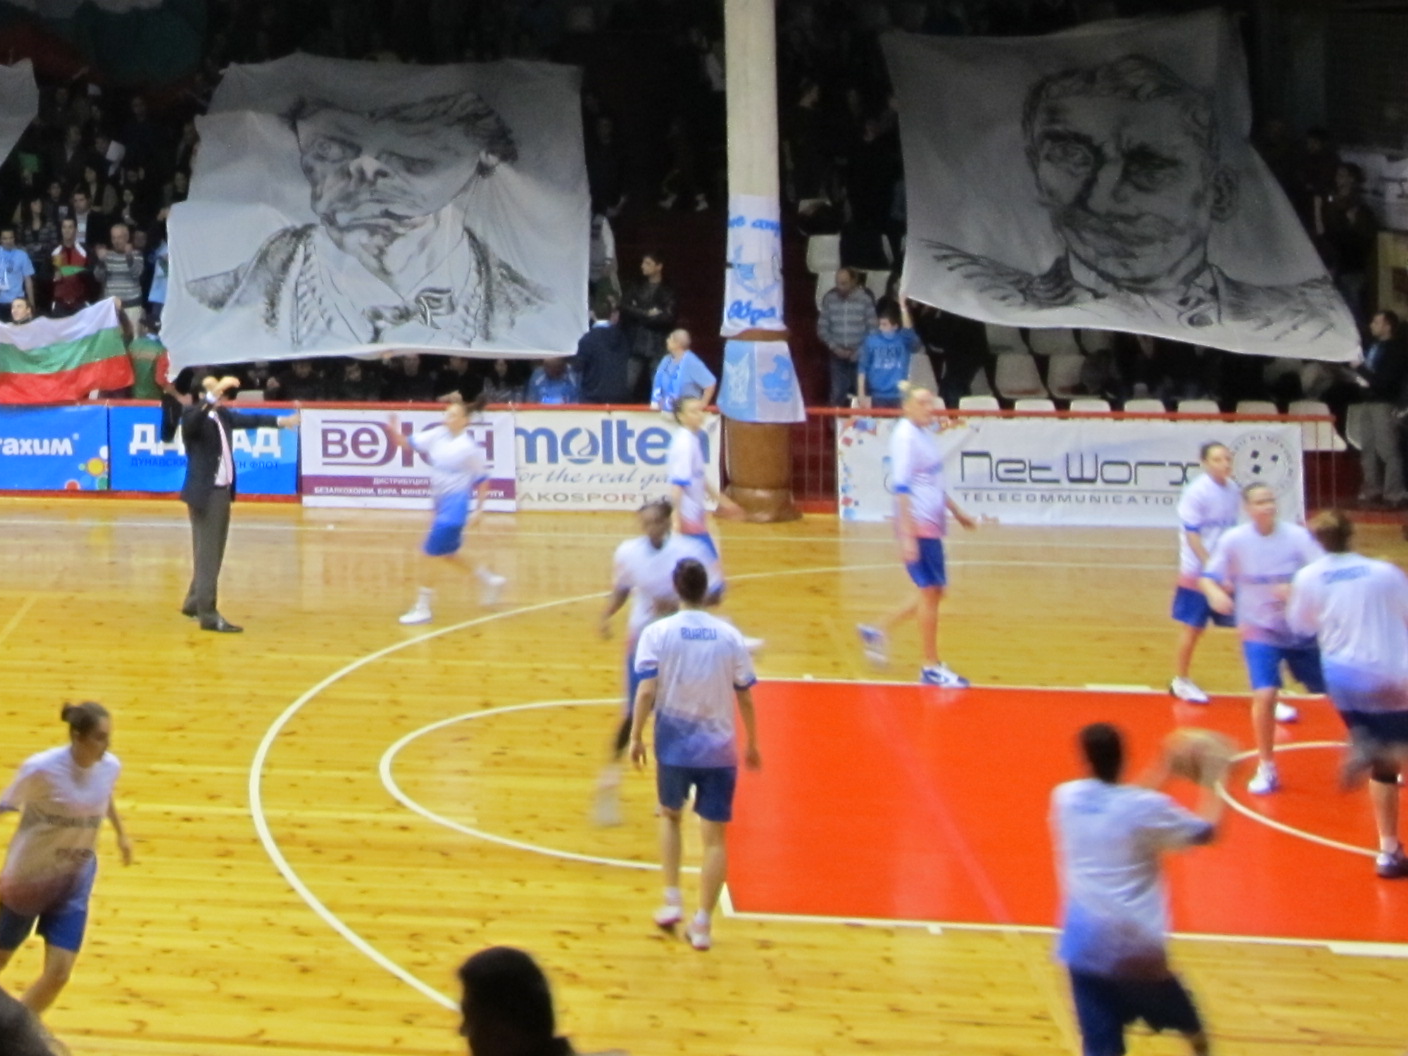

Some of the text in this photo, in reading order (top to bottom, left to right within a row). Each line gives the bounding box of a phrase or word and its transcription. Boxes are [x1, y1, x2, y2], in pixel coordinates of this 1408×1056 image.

[514, 419, 710, 466] molte
[546, 467, 582, 485] the
[588, 468, 638, 485] real
[962, 493, 1174, 506] TELECOMMUNICATIO
